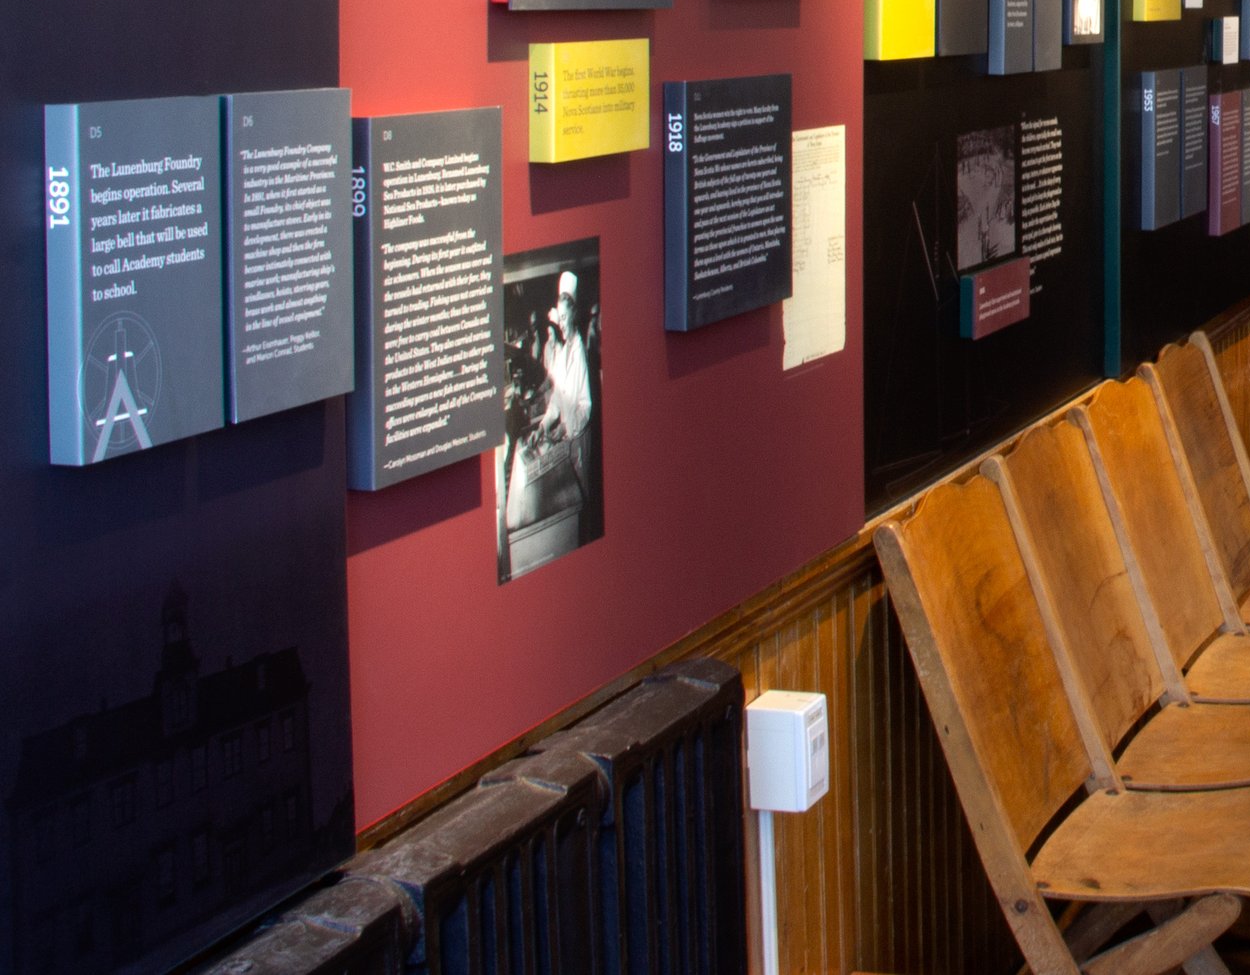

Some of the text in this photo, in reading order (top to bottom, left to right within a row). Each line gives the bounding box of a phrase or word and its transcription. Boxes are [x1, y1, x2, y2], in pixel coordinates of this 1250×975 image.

[534, 71, 548, 114] 1914
[668, 113, 682, 152] 1918
[90, 155, 202, 179] The Lunenburg Foundry
[49, 166, 70, 230] 1891
[91, 176, 204, 204] begins operation. Several
[351, 166, 366, 218] 1899
[91, 204, 202, 231] years later it fabricates a
[92, 222, 208, 253] large bell that will be used
[92, 248, 205, 277] to call Academy students
[92, 280, 137, 301] to school.
